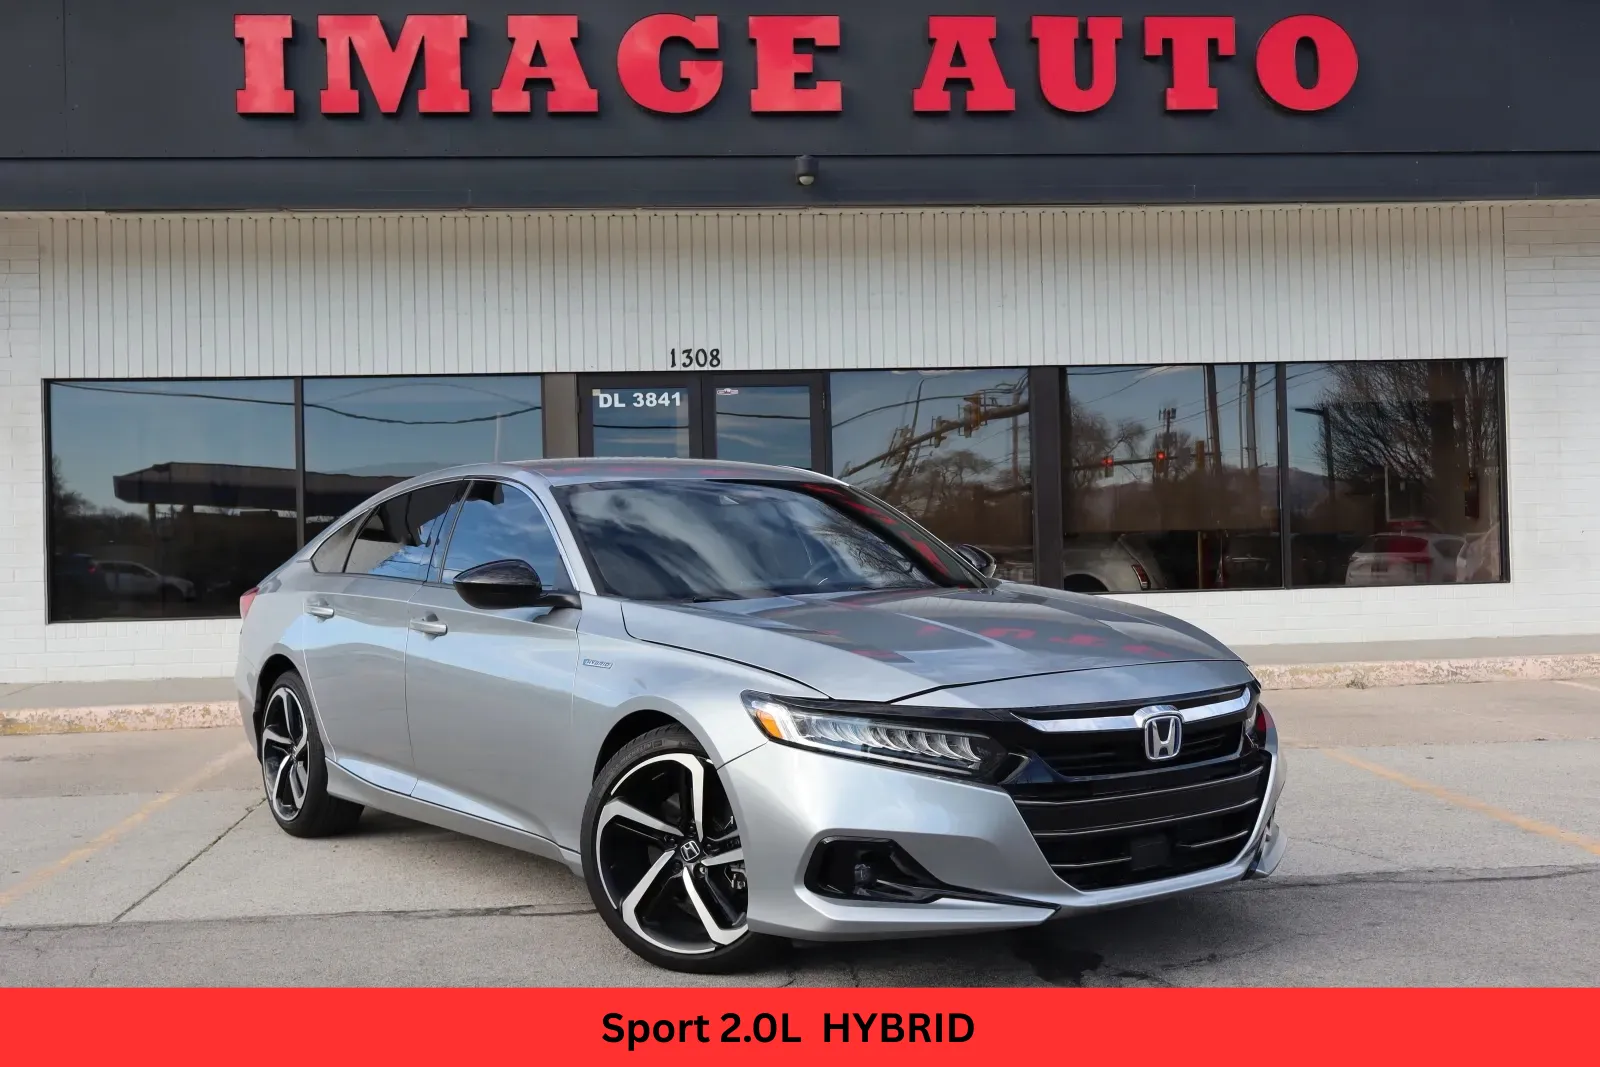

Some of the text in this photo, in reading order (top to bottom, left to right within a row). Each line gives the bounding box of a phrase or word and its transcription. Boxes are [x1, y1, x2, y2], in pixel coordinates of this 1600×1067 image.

[234, 13, 1359, 114] IMAGE AUTO
[670, 348, 721, 368] 1308
[598, 391, 681, 408] DL 3841
